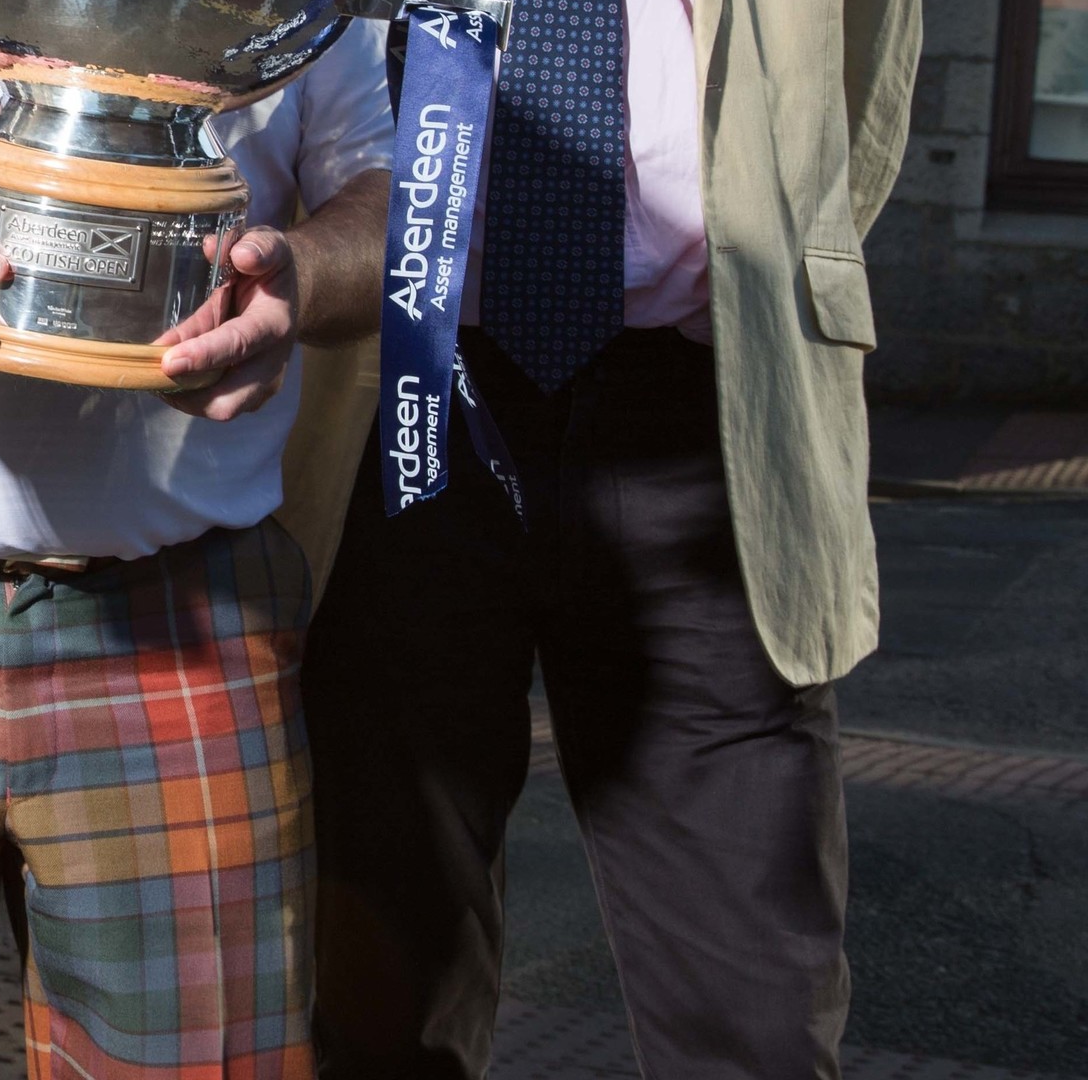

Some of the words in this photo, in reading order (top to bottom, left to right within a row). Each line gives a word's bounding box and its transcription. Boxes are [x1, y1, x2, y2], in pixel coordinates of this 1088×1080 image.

[388, 103, 451, 321] Aberdeen
[441, 122, 474, 250] management
[8, 216, 88, 243] Aberdeen
[4, 244, 81, 271] SCOTTISH
[84, 258, 129, 276] OPEN
[430, 256, 454, 312] Asset
